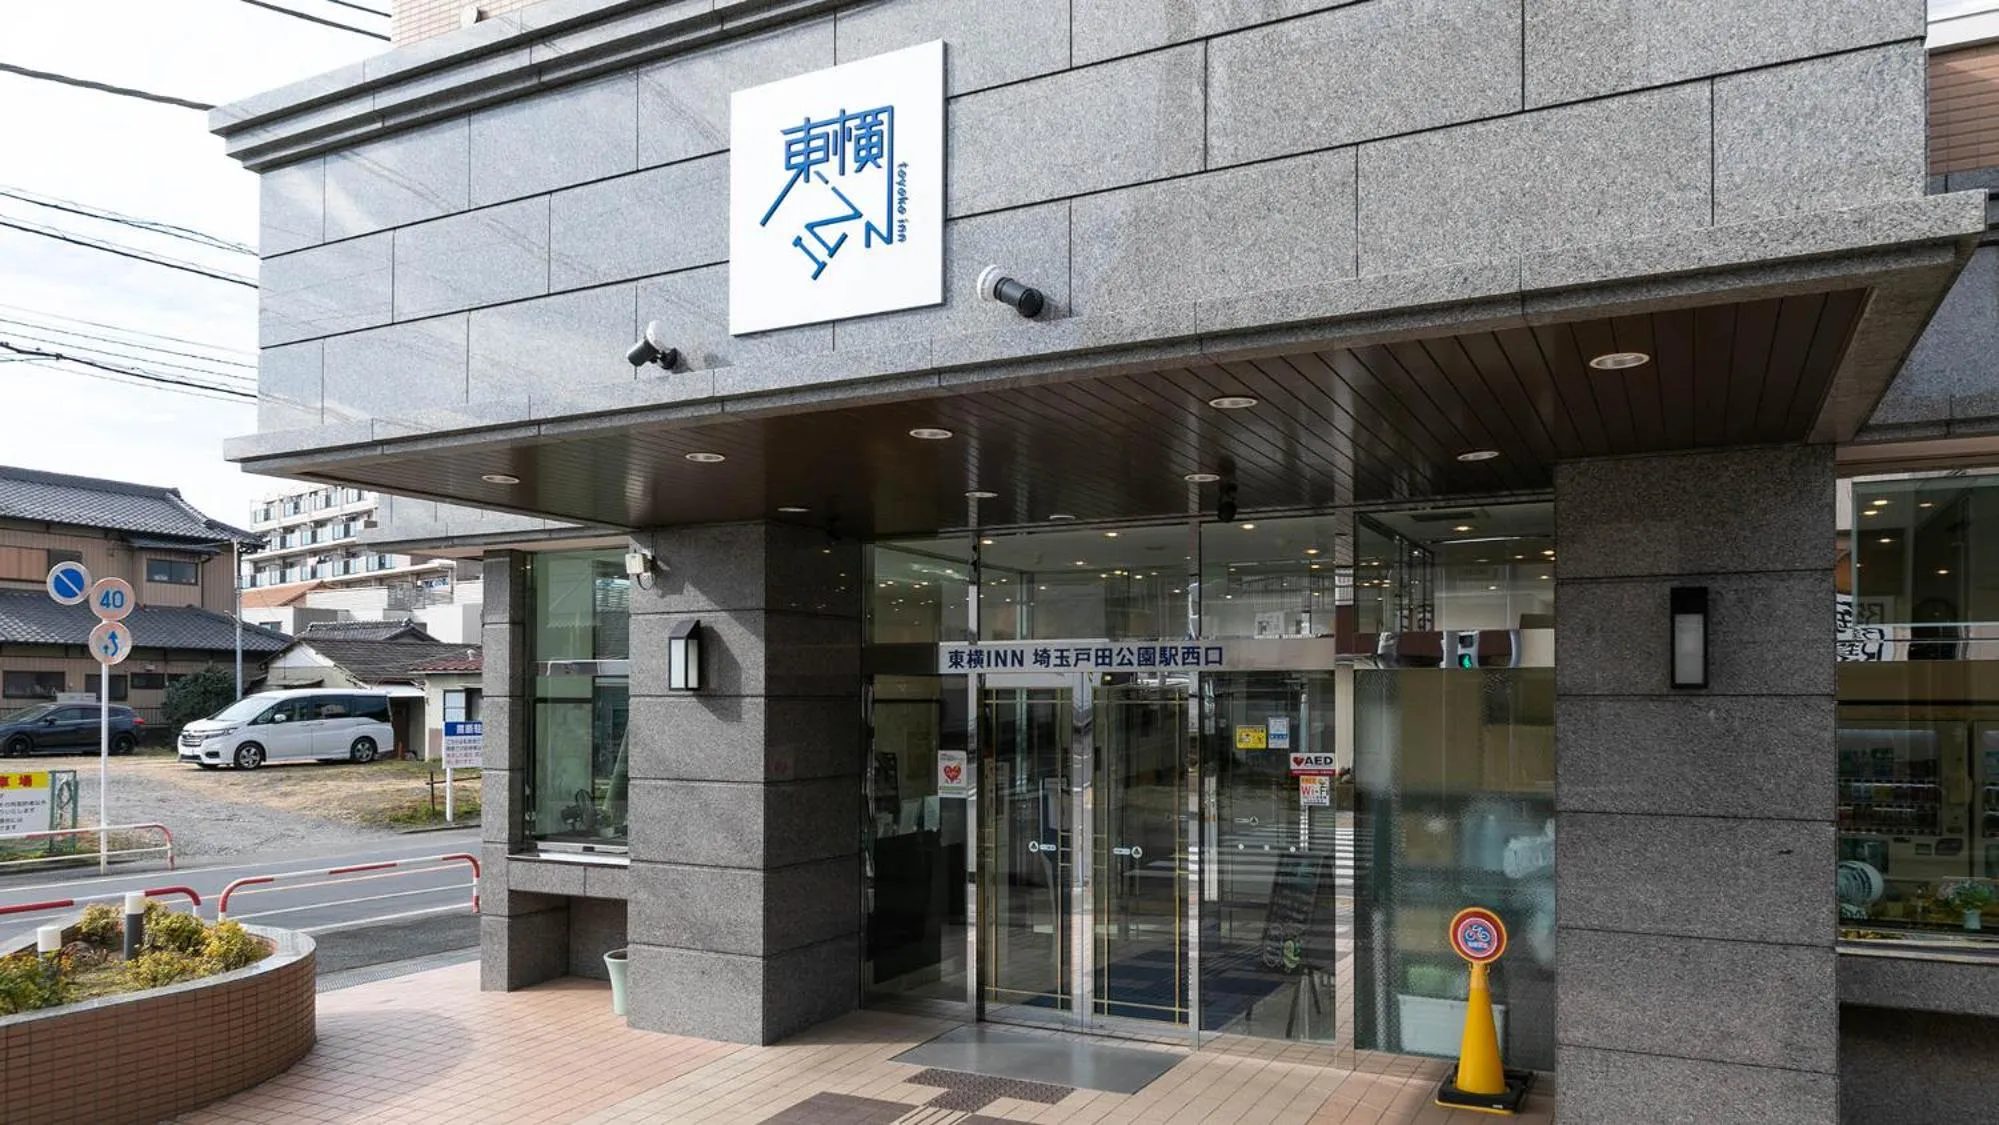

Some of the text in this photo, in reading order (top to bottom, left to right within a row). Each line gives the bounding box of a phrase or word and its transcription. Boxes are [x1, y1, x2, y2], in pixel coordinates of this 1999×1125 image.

[896, 161, 909, 243] toyoko inn
[99, 590, 125, 609] 40
[948, 646, 1223, 669] 東横INN 埼玉戸田公園駅西口
[1304, 756, 1333, 765] AED
